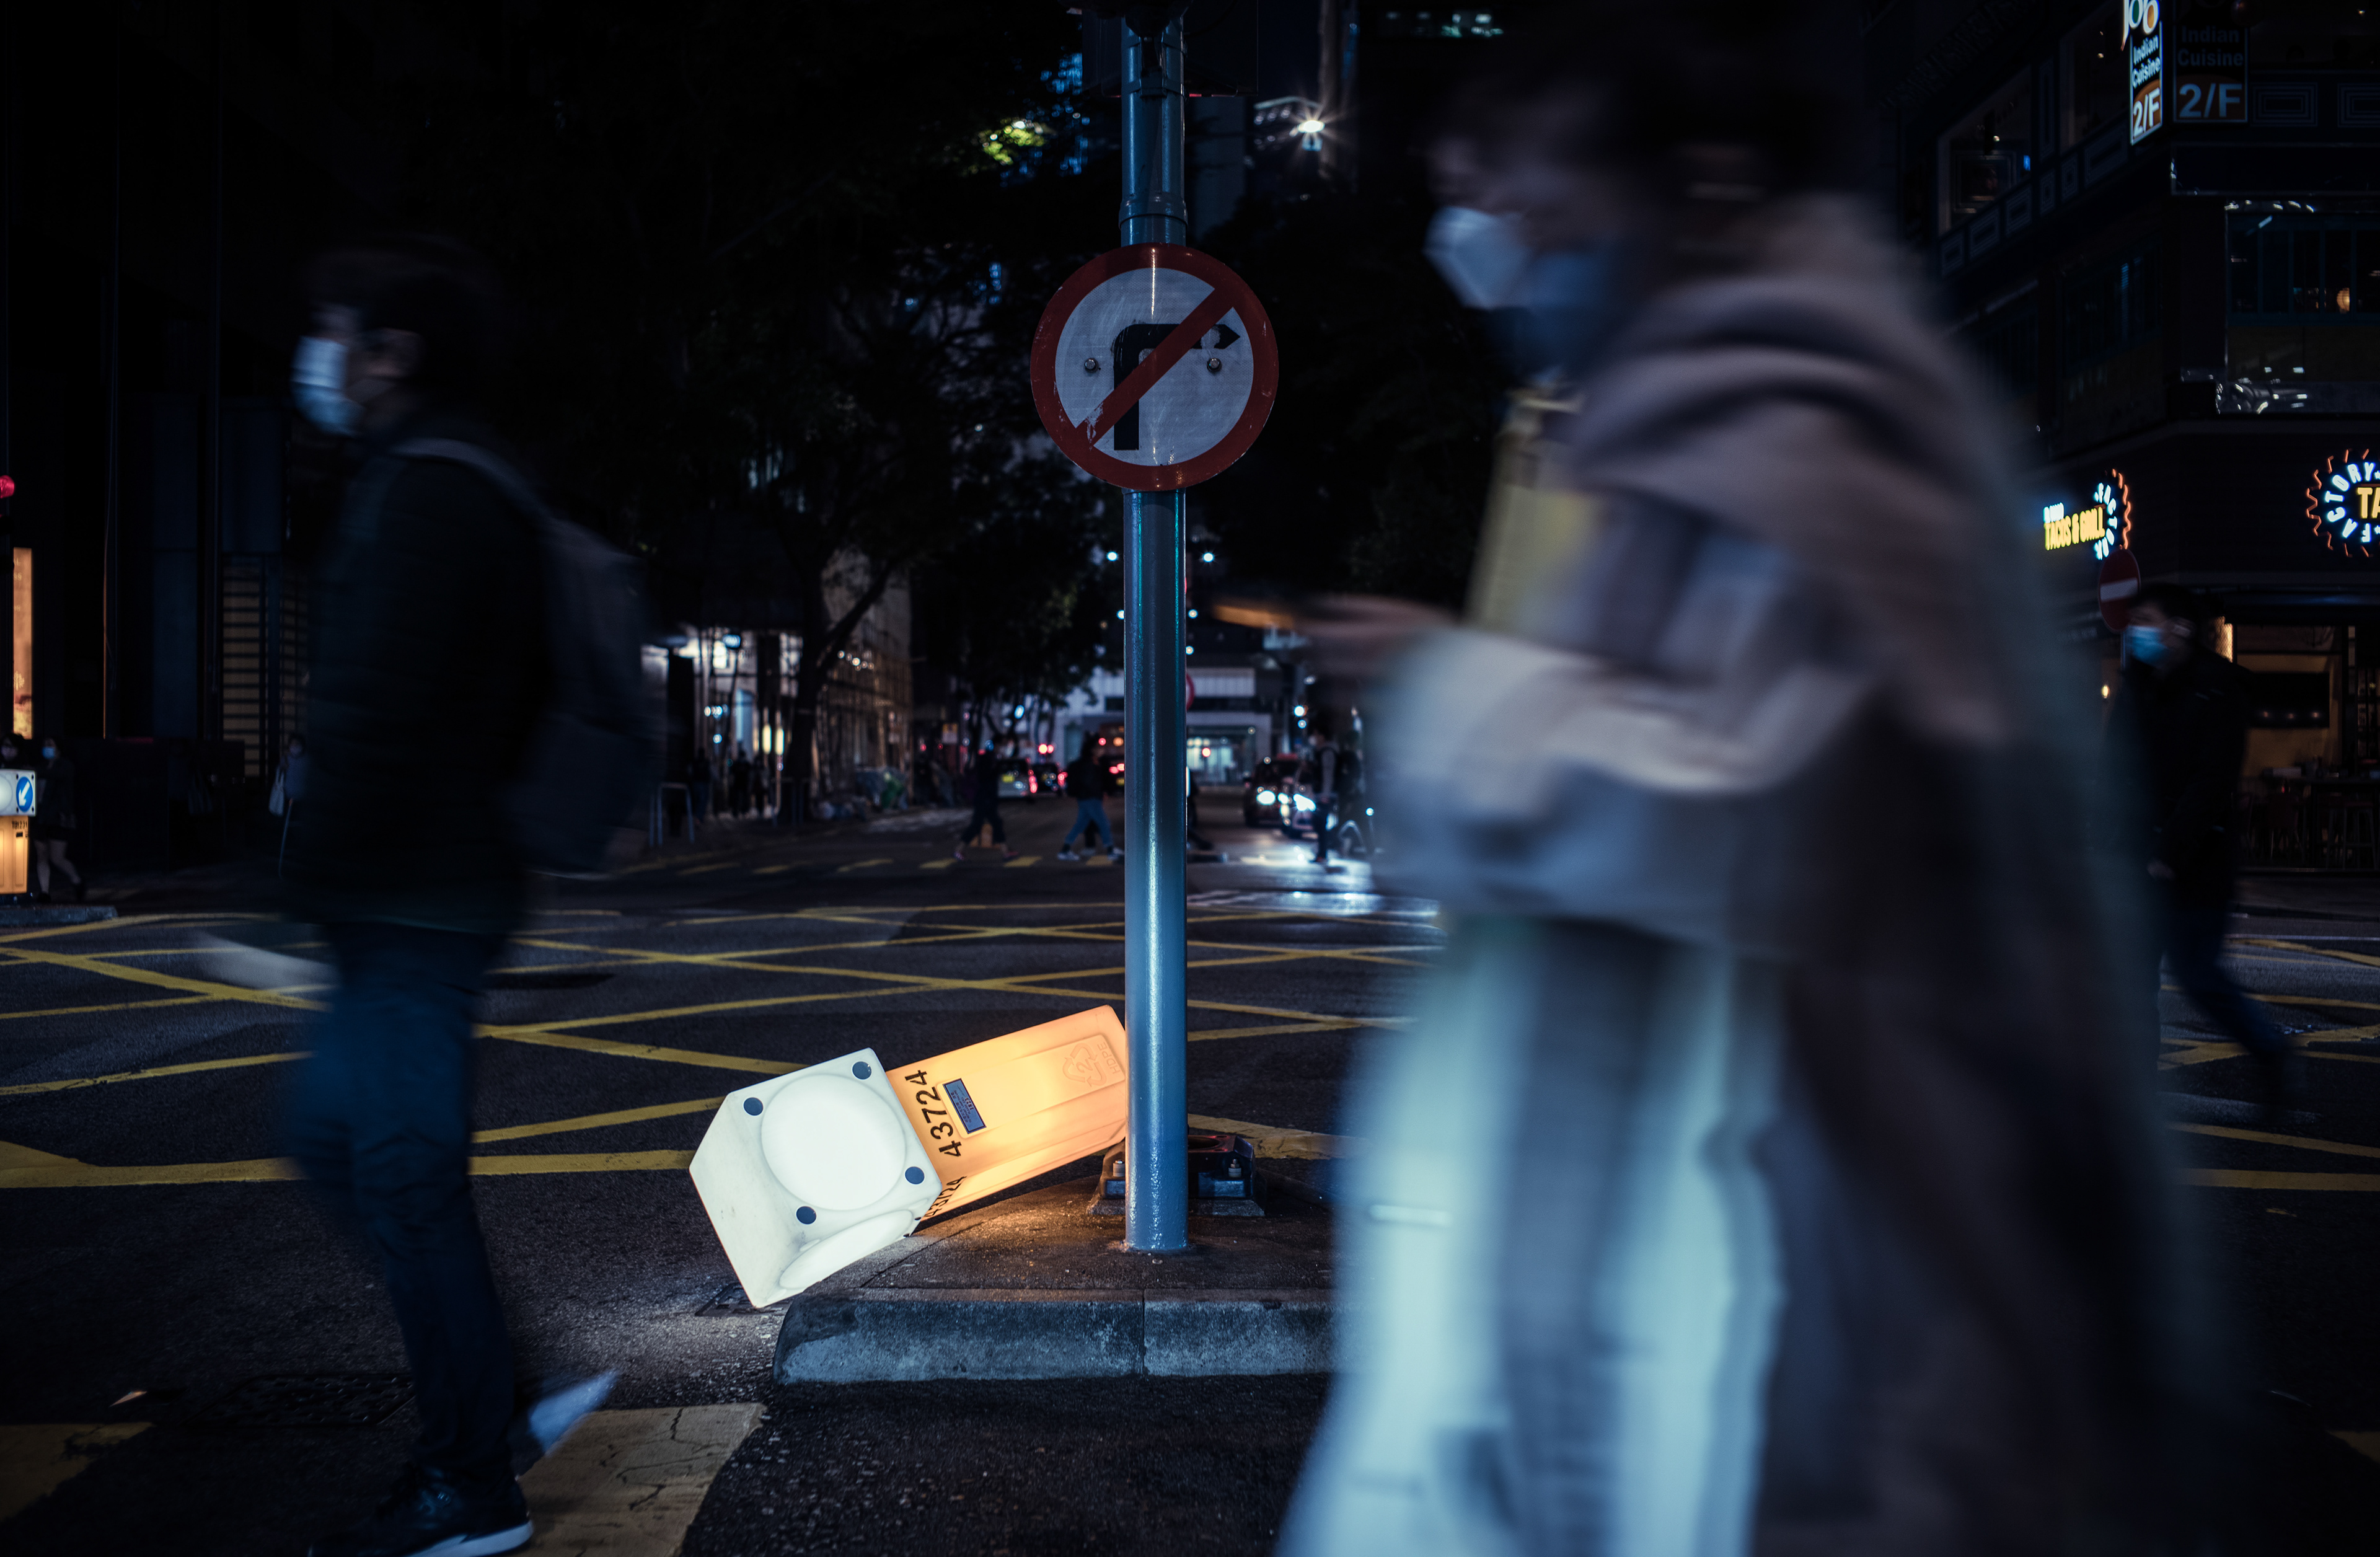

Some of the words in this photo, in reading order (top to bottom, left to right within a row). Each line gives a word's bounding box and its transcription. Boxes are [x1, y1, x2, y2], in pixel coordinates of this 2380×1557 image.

[2133, 35, 2159, 65] Indian
[2181, 25, 2239, 43] Indian
[2133, 56, 2161, 89] Cuisine
[2177, 48, 2244, 67] Cuisine
[2133, 87, 2160, 138] 2/F
[2179, 83, 2242, 118] 2/F
[2325, 462, 2375, 542] FACTORY
[1097, 1042, 1121, 1075] HDPE
[904, 1069, 962, 1157] 43724
[965, 1097, 974, 1110] 1823
